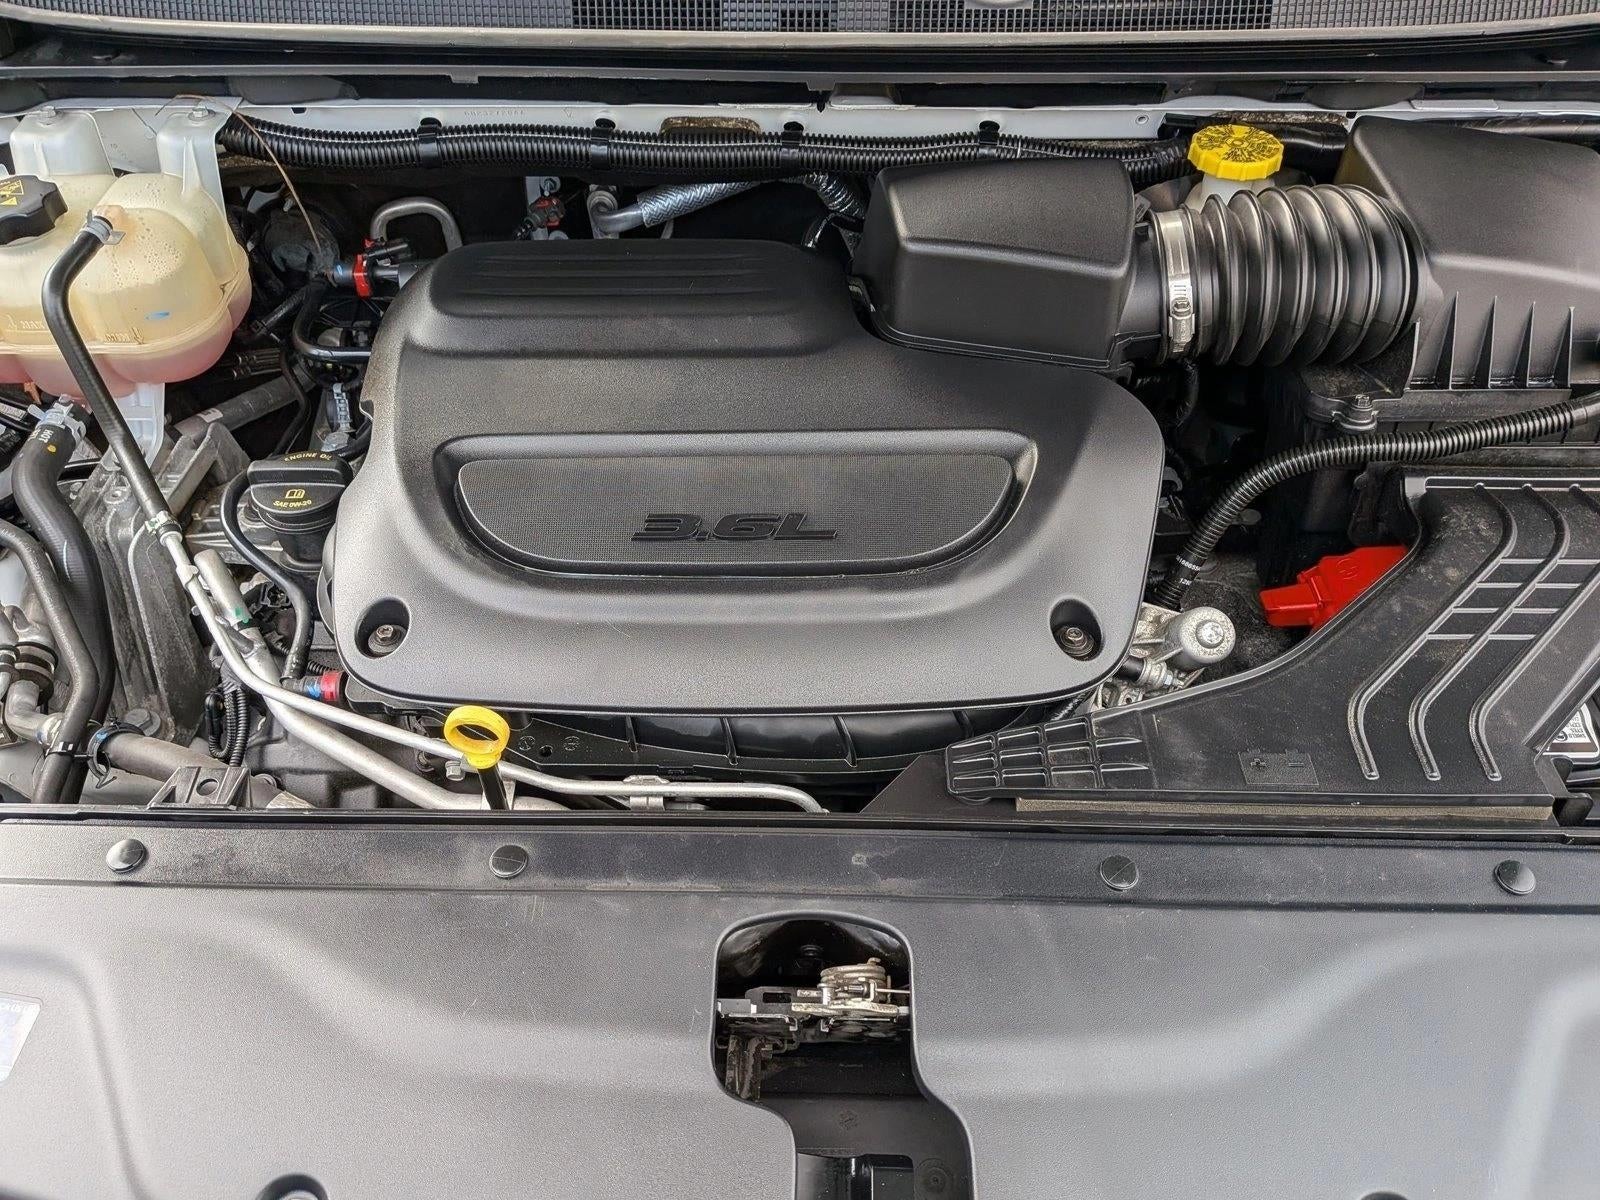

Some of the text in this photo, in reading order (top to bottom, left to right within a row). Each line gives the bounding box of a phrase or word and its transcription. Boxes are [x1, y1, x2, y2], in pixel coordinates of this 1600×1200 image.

[39, 429, 54, 443] HOT
[284, 452, 332, 461] ENGINE OIL
[273, 499, 312, 508] SAE 0W-20
[631, 513, 838, 542] 3.6L
